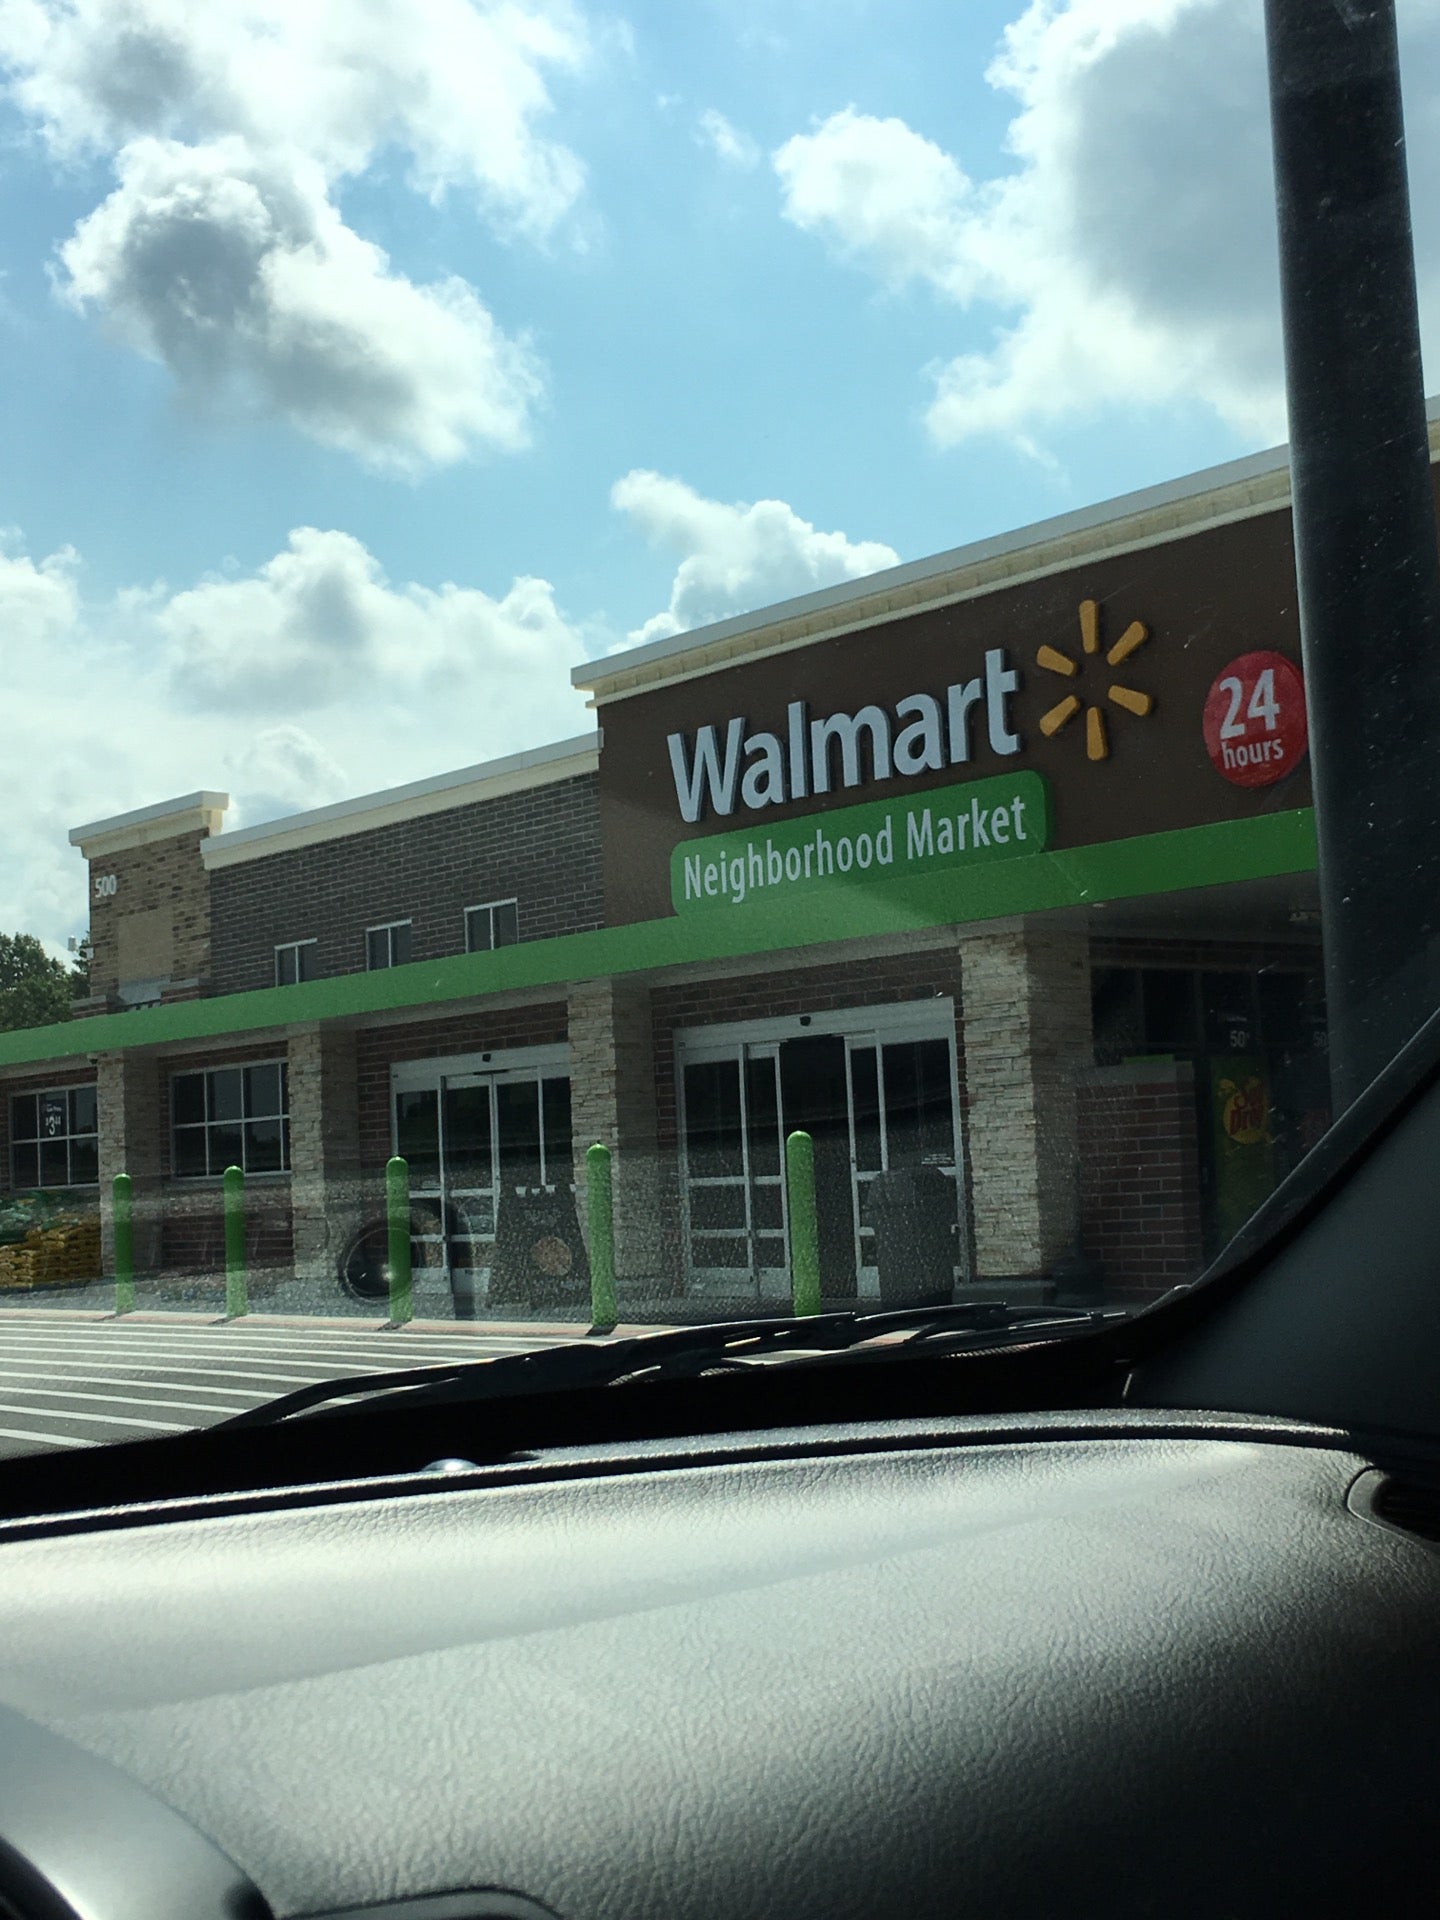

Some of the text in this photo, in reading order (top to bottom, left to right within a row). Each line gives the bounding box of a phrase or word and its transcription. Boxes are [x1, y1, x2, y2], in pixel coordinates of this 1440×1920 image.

[666, 648, 1021, 823] Walmart
[1219, 667, 1280, 739] 24
[1223, 738, 1284, 769] hours
[683, 795, 1027, 904] Neighborhood Market
[95, 874, 117, 898] 500
